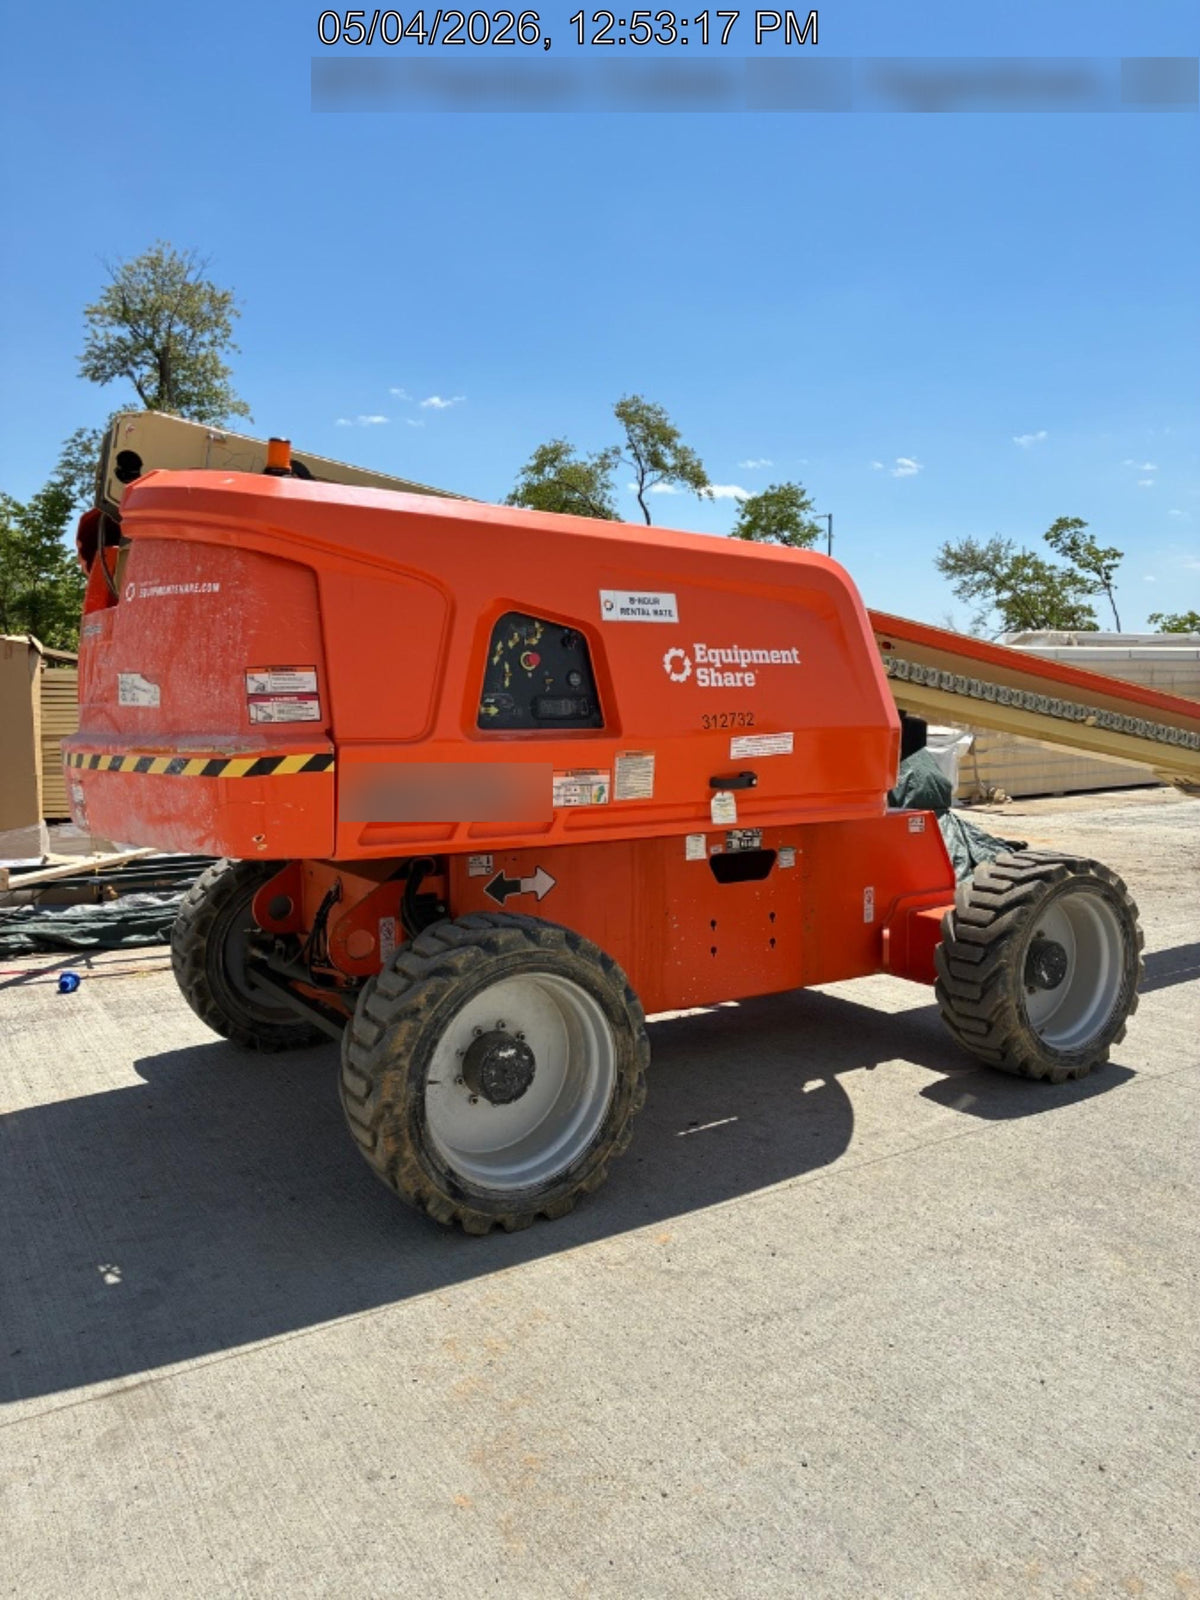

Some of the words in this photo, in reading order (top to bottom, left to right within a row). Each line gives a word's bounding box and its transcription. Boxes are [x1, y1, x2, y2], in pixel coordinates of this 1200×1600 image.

[619, 607, 651, 617] RENTAL
[693, 643, 801, 668] Equipment
[696, 667, 756, 687] Share
[701, 711, 755, 730] 312732
